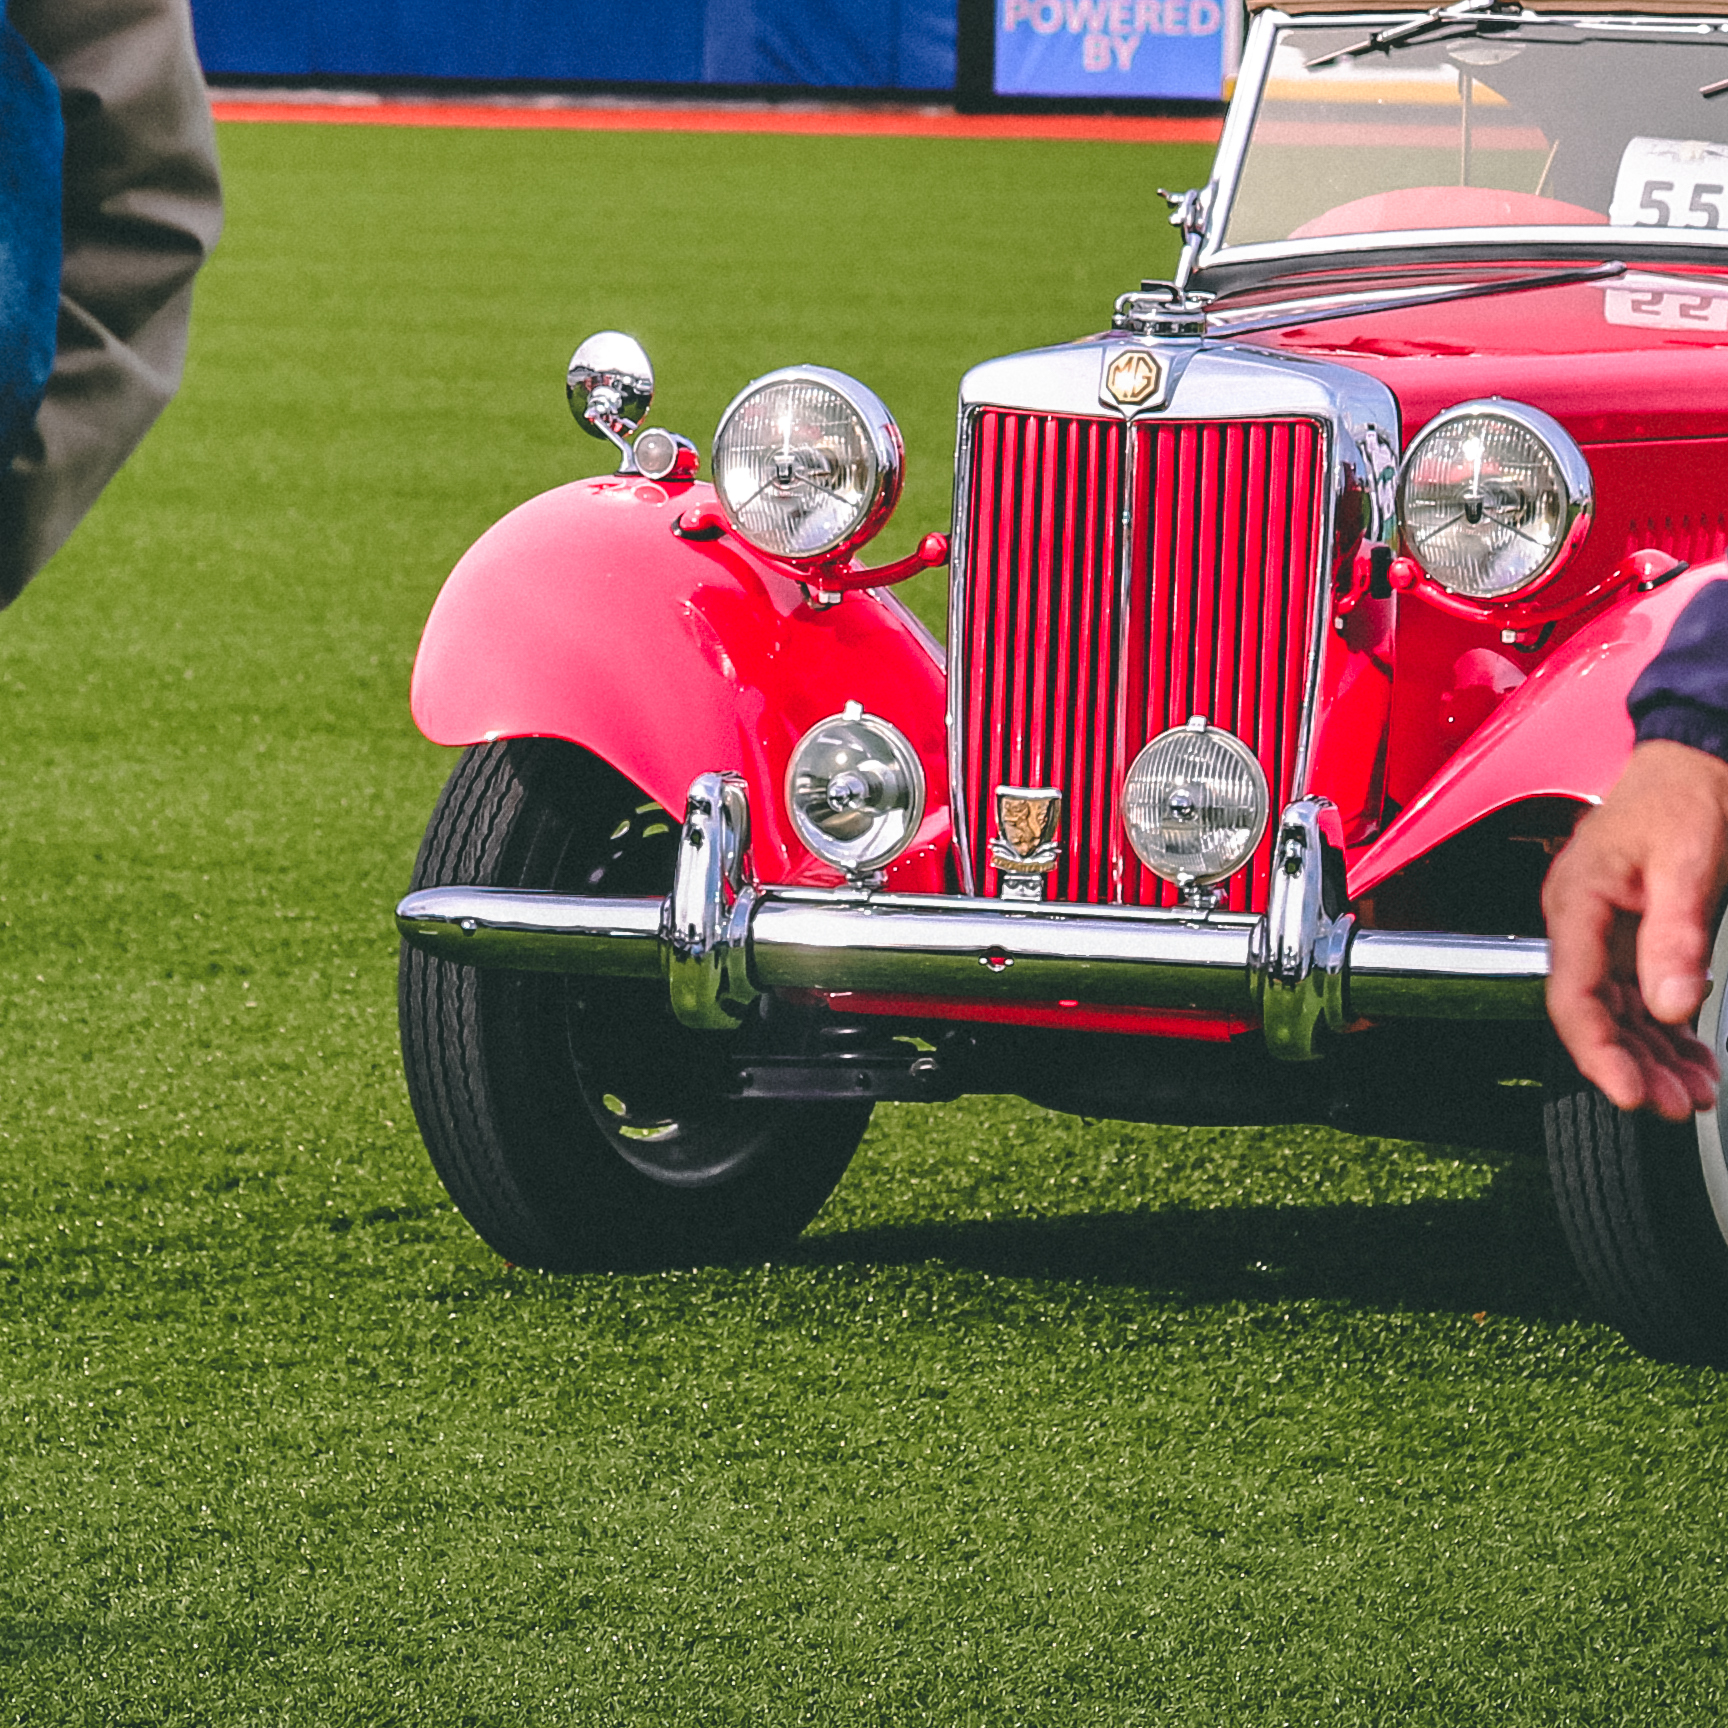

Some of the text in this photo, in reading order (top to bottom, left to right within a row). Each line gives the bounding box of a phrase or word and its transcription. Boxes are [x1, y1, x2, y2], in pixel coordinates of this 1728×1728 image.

[1083, 34, 1142, 71] BY
[1638, 180, 1724, 228] 55
[1111, 355, 1153, 399] MG
